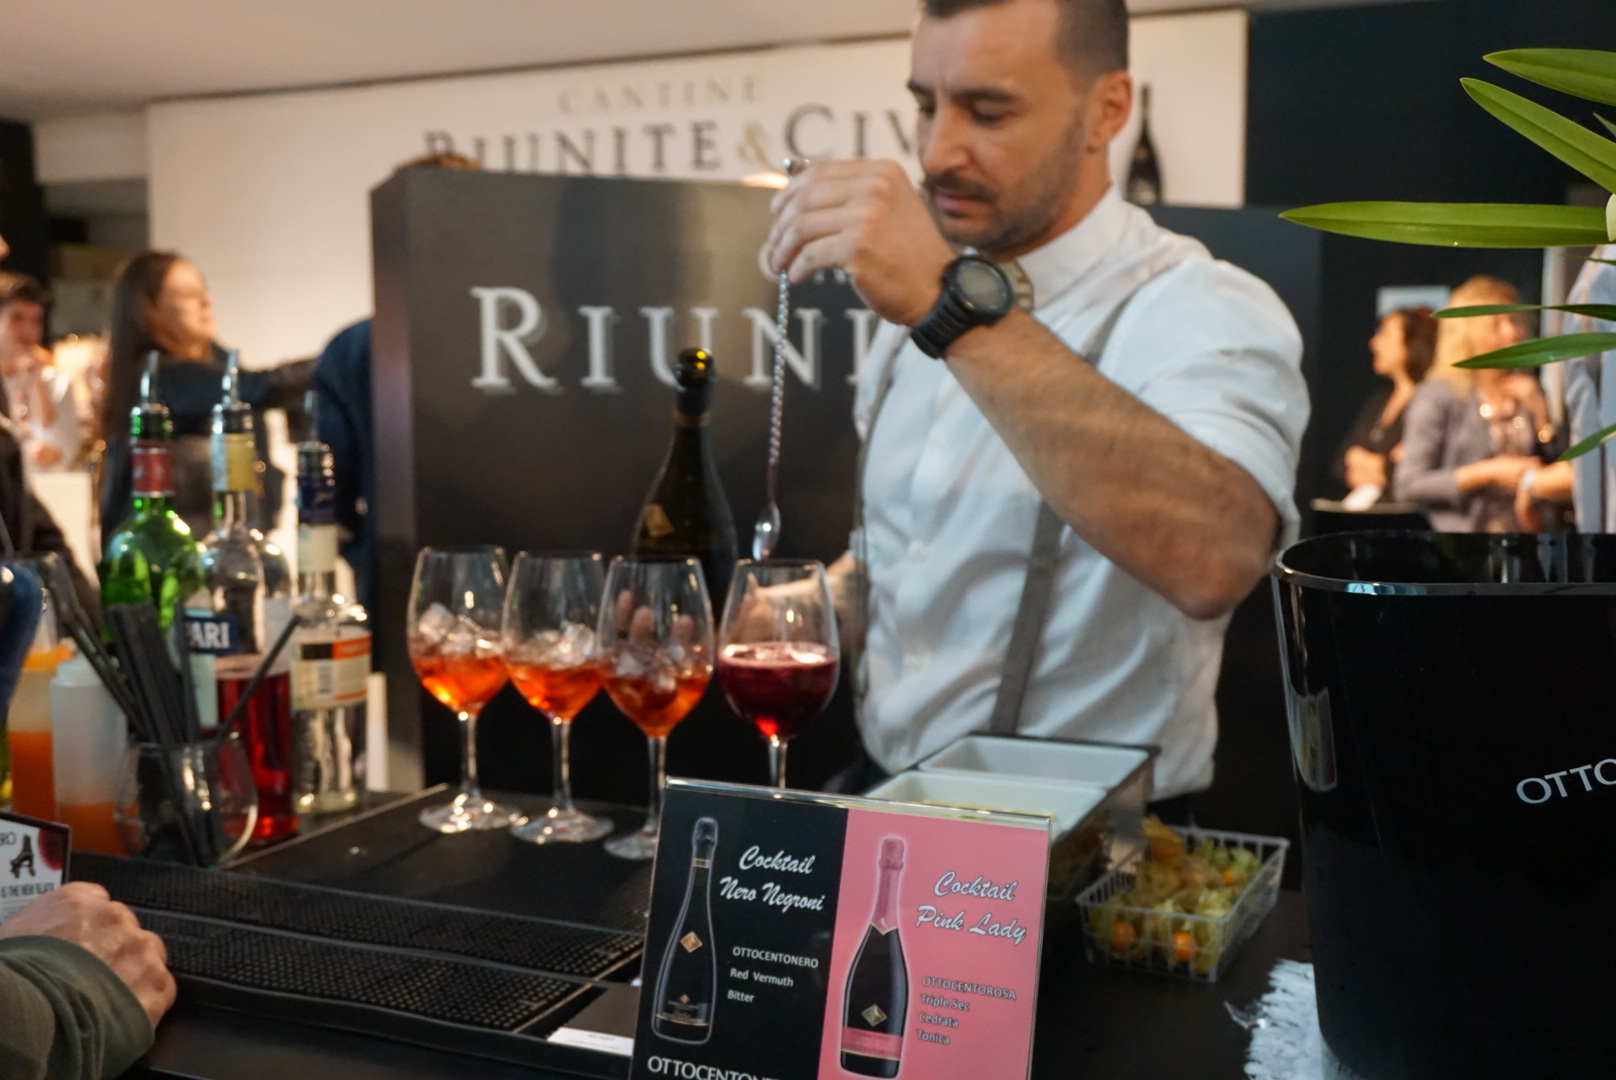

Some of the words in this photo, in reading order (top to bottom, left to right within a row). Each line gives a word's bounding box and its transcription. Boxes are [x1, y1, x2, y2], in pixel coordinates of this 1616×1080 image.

[557, 74, 760, 114] CANTINE
[735, 122, 773, 167] &
[739, 845, 816, 874] Cocktail
[719, 876, 757, 901] Nero
[761, 882, 825, 913] Negroni
[933, 871, 1018, 901] Cocktail
[916, 905, 964, 931] Pink
[969, 914, 1027, 945] Lady
[732, 946, 819, 968] OTTOCENTONERO
[730, 968, 749, 981] Red
[753, 972, 794, 987] Vermuth
[922, 976, 1017, 1000] OTTOCENTOROSA
[727, 990, 755, 1002] Bitter
[921, 994, 950, 1009] Triple
[952, 999, 970, 1011] Sec
[918, 1012, 959, 1028] Cedrata
[917, 1030, 950, 1045] Tonica
